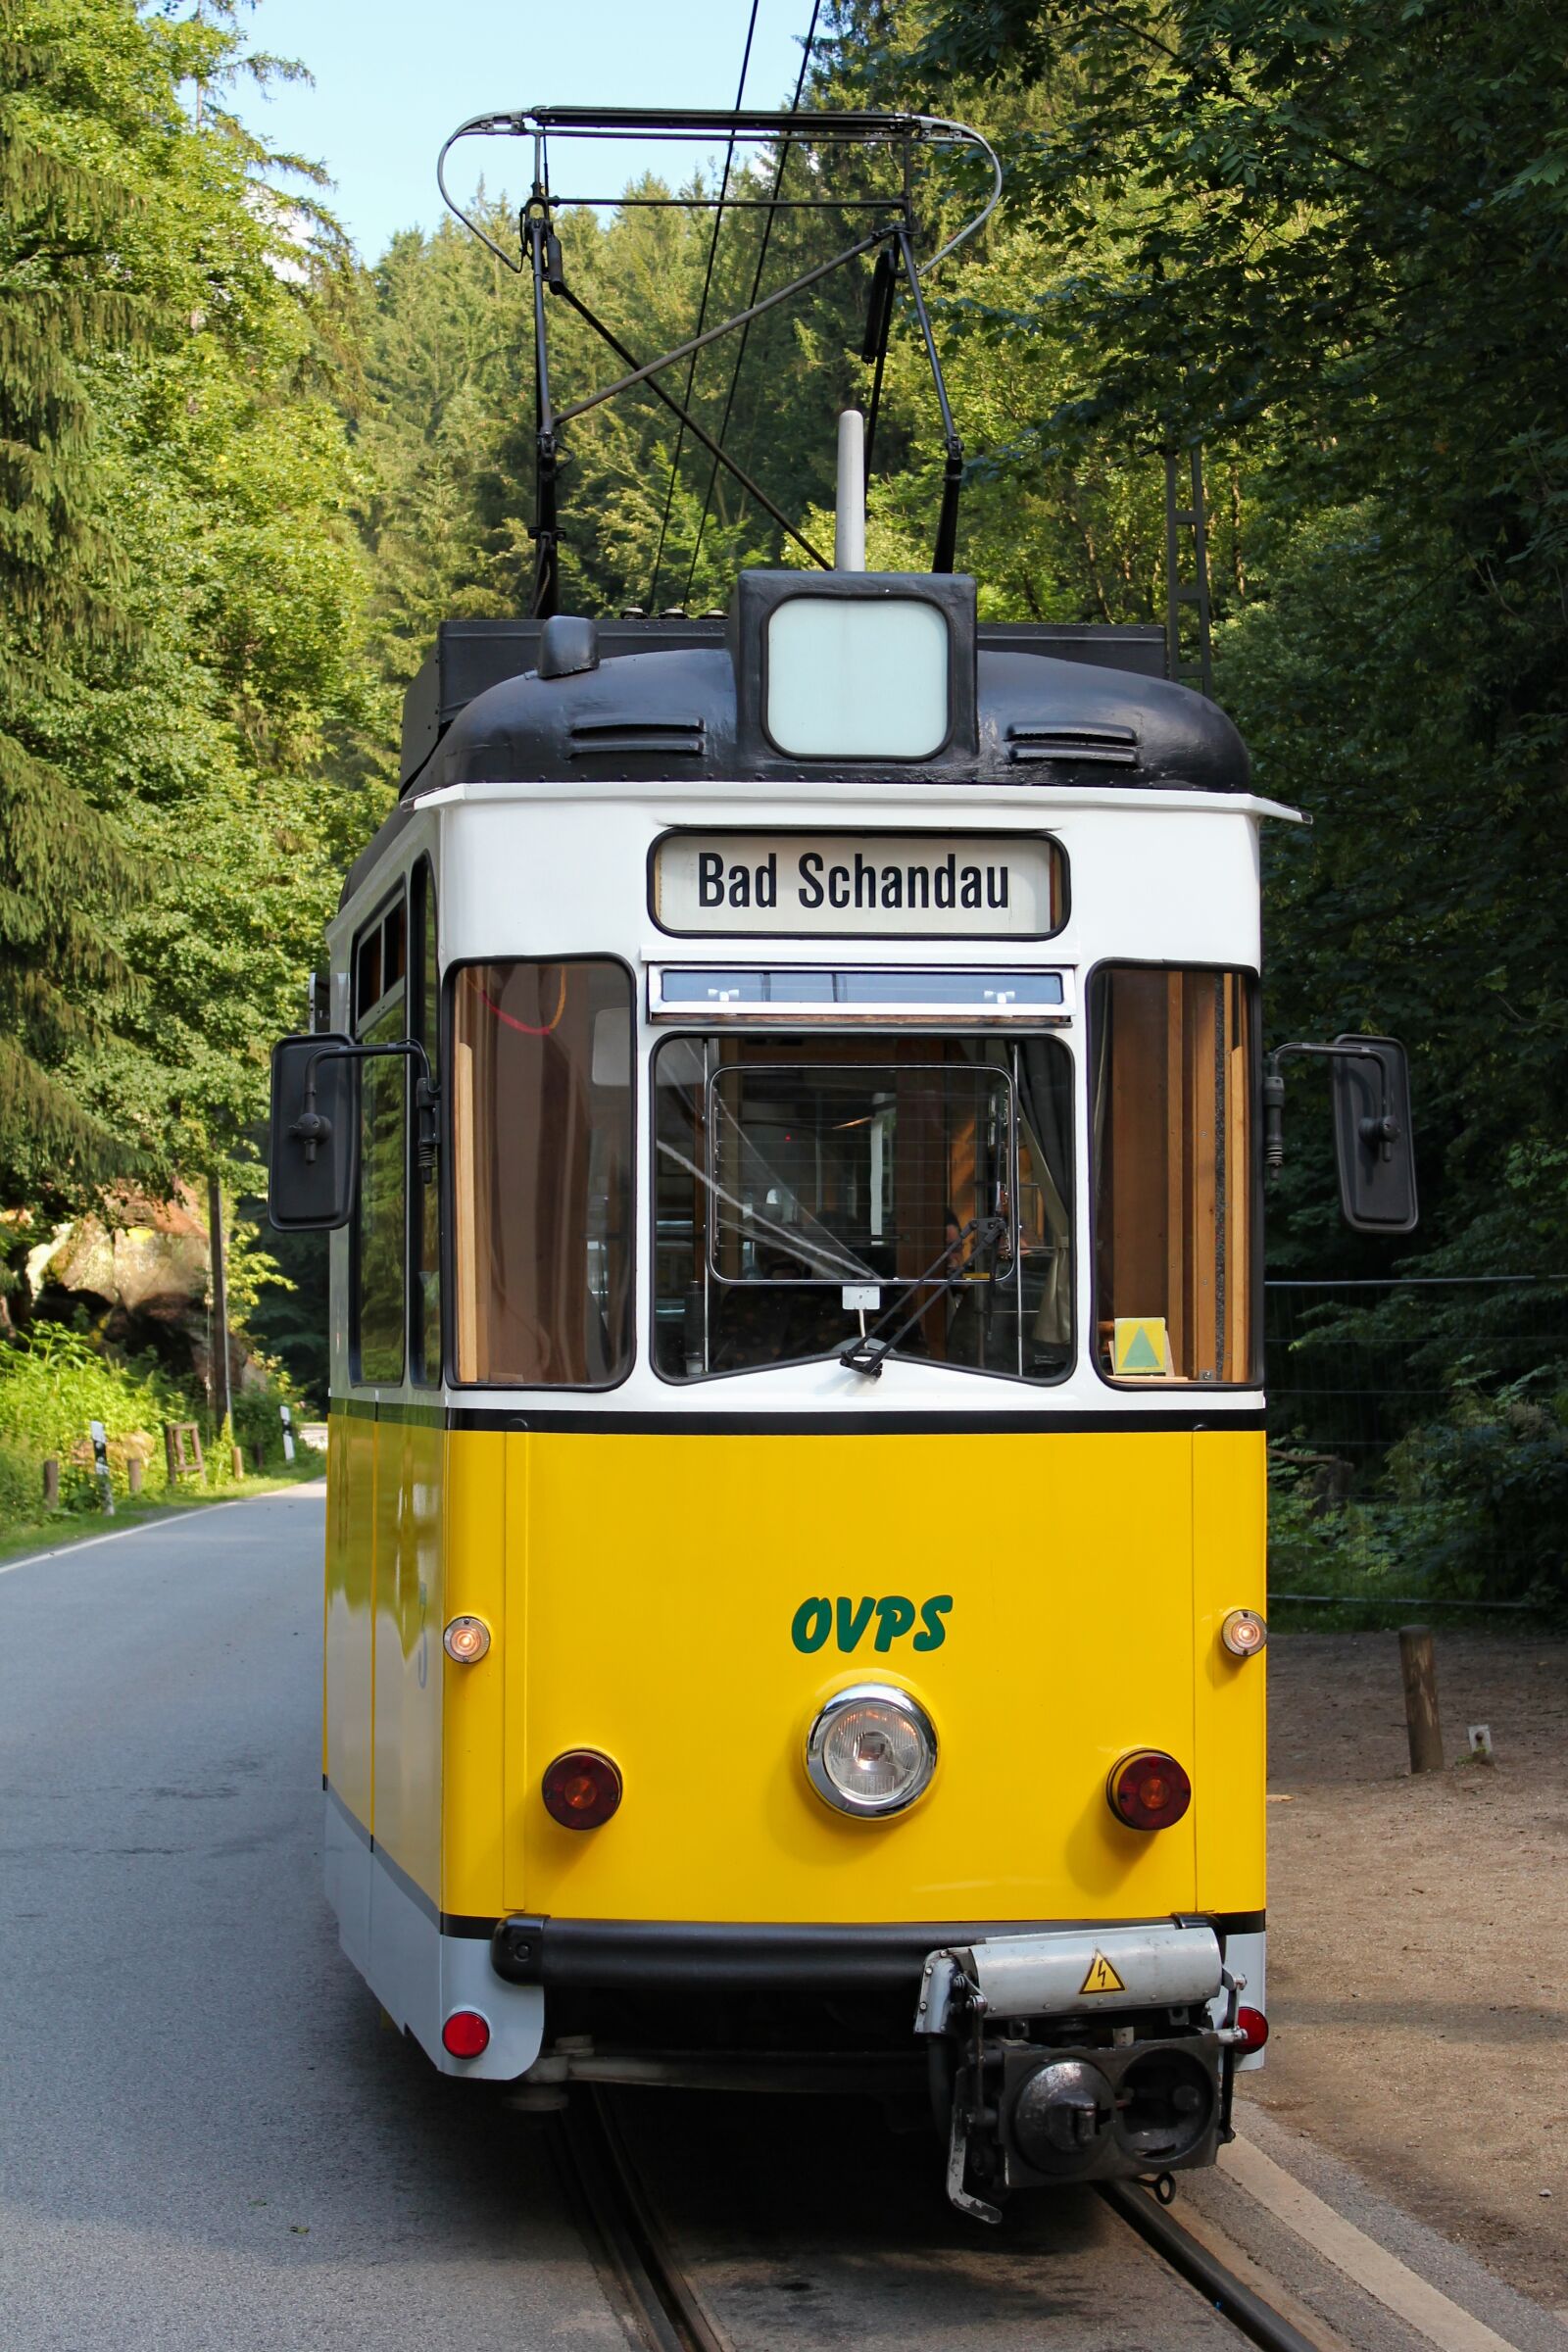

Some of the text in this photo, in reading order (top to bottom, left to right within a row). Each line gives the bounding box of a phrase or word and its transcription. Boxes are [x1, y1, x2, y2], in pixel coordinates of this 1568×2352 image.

[699, 852, 1008, 909] Bad Schandau
[791, 1594, 954, 1654] OVPS
